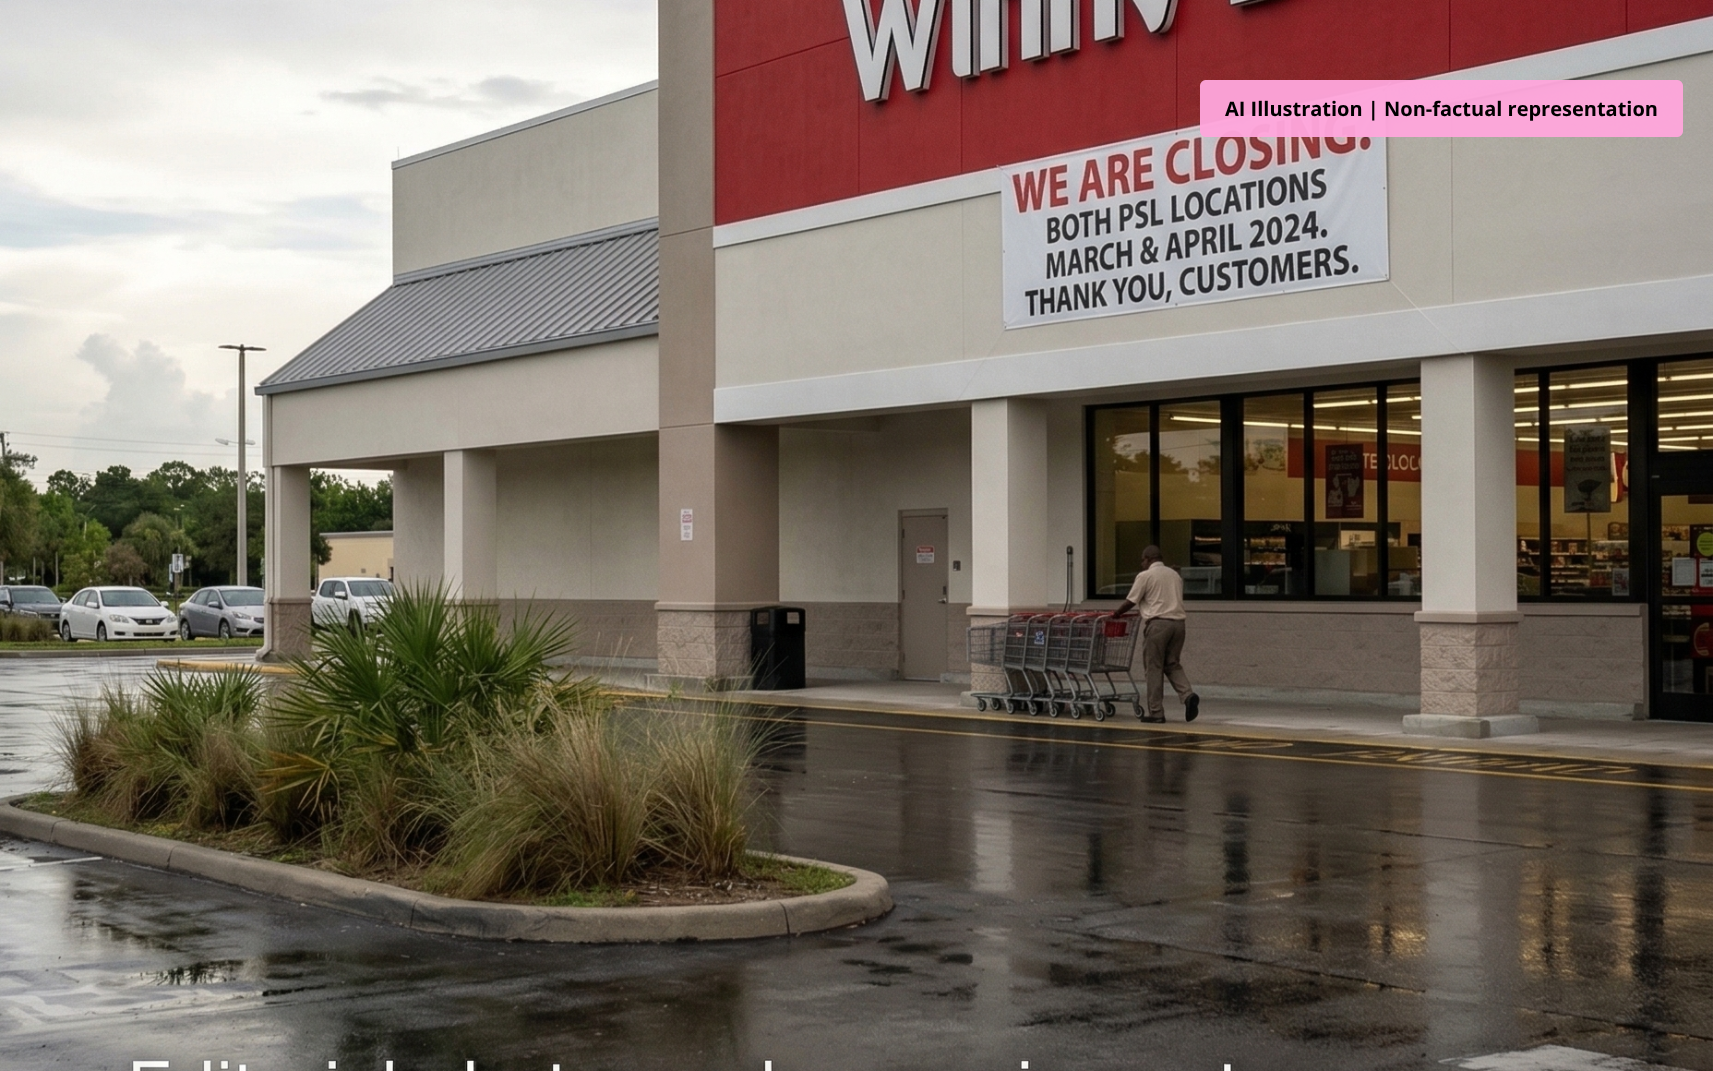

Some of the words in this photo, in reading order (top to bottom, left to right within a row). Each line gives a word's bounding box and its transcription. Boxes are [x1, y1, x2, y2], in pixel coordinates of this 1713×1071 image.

[1012, 164, 1069, 213] WE
[1078, 147, 1155, 202] ARE
[1046, 207, 1111, 244] BOTH
[1119, 199, 1164, 232] PSL
[1171, 168, 1327, 223] LOCATIONS
[1024, 279, 1108, 316] THANK
[1112, 271, 1172, 304] YOU,
[1179, 244, 1359, 296] CUSTOMERS.
[1046, 239, 1133, 279] MARCH
[1139, 236, 1159, 265] &
[1165, 223, 1242, 262] APRIL
[1249, 211, 1328, 249] 2024.
